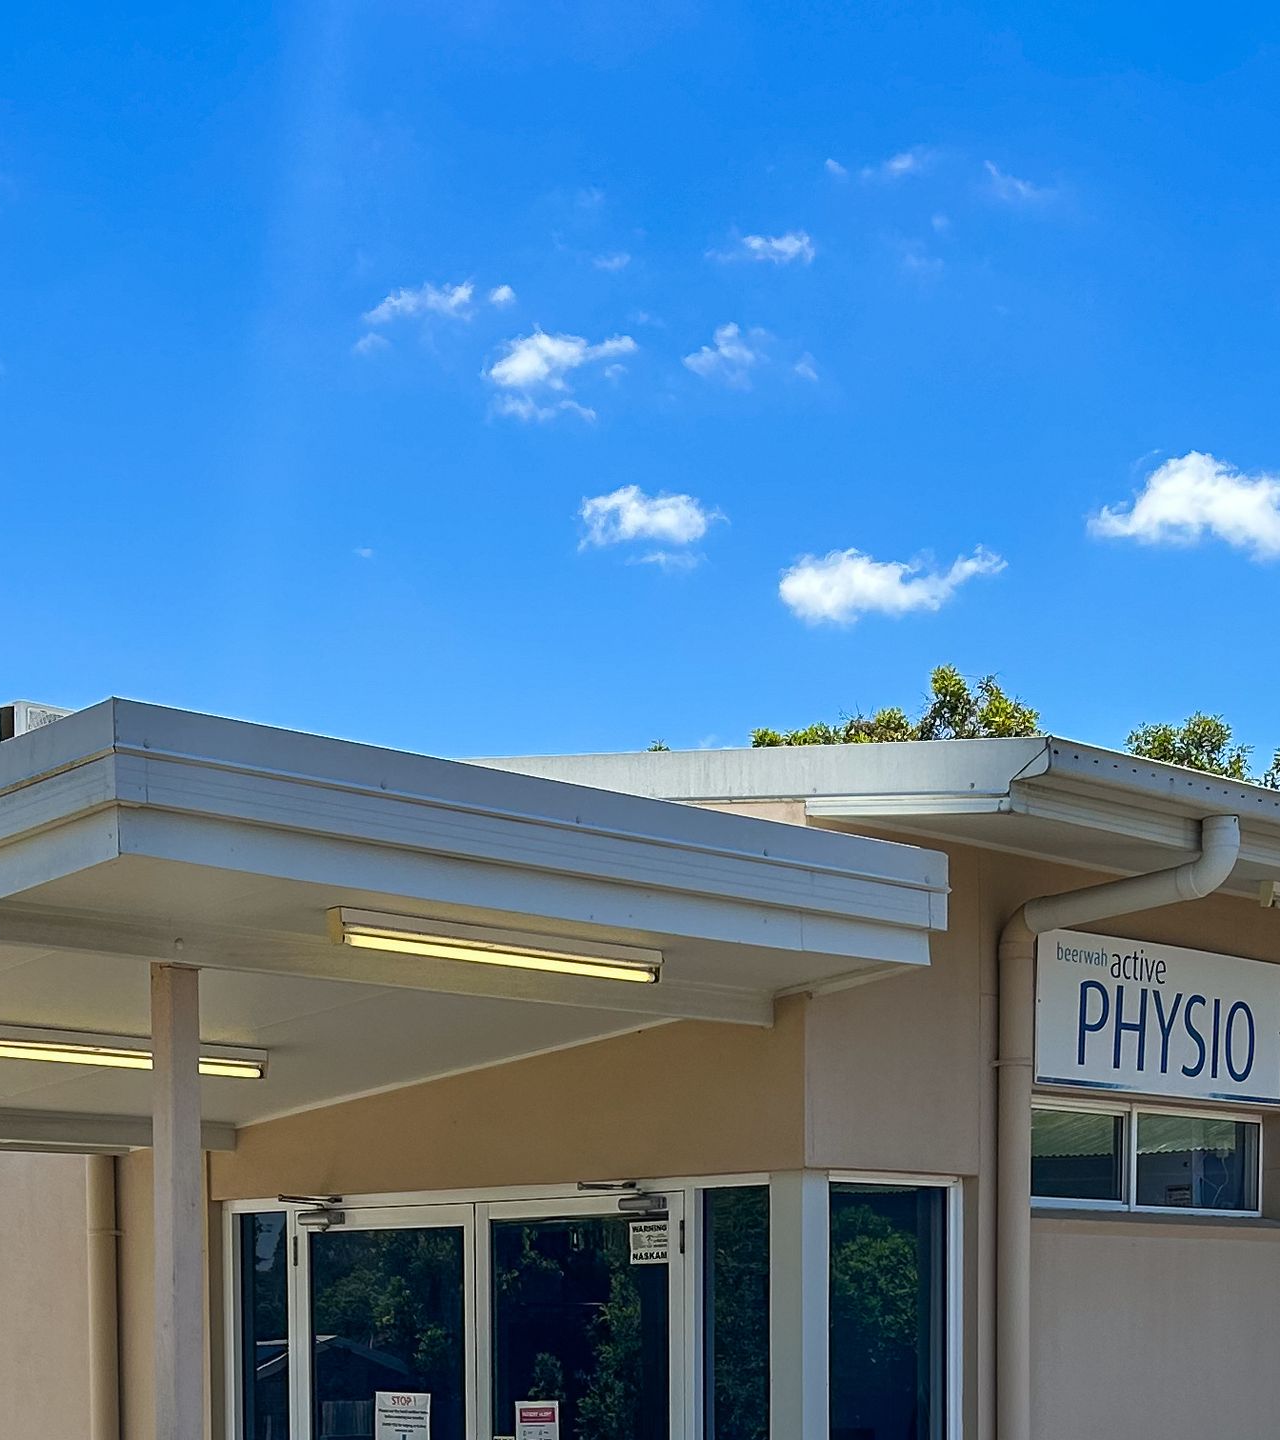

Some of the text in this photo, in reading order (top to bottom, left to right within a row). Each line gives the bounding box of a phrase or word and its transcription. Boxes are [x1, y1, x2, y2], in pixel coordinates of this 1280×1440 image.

[1056, 942, 1167, 984] beerwah active
[1077, 980, 1255, 1083] PHYSIO
